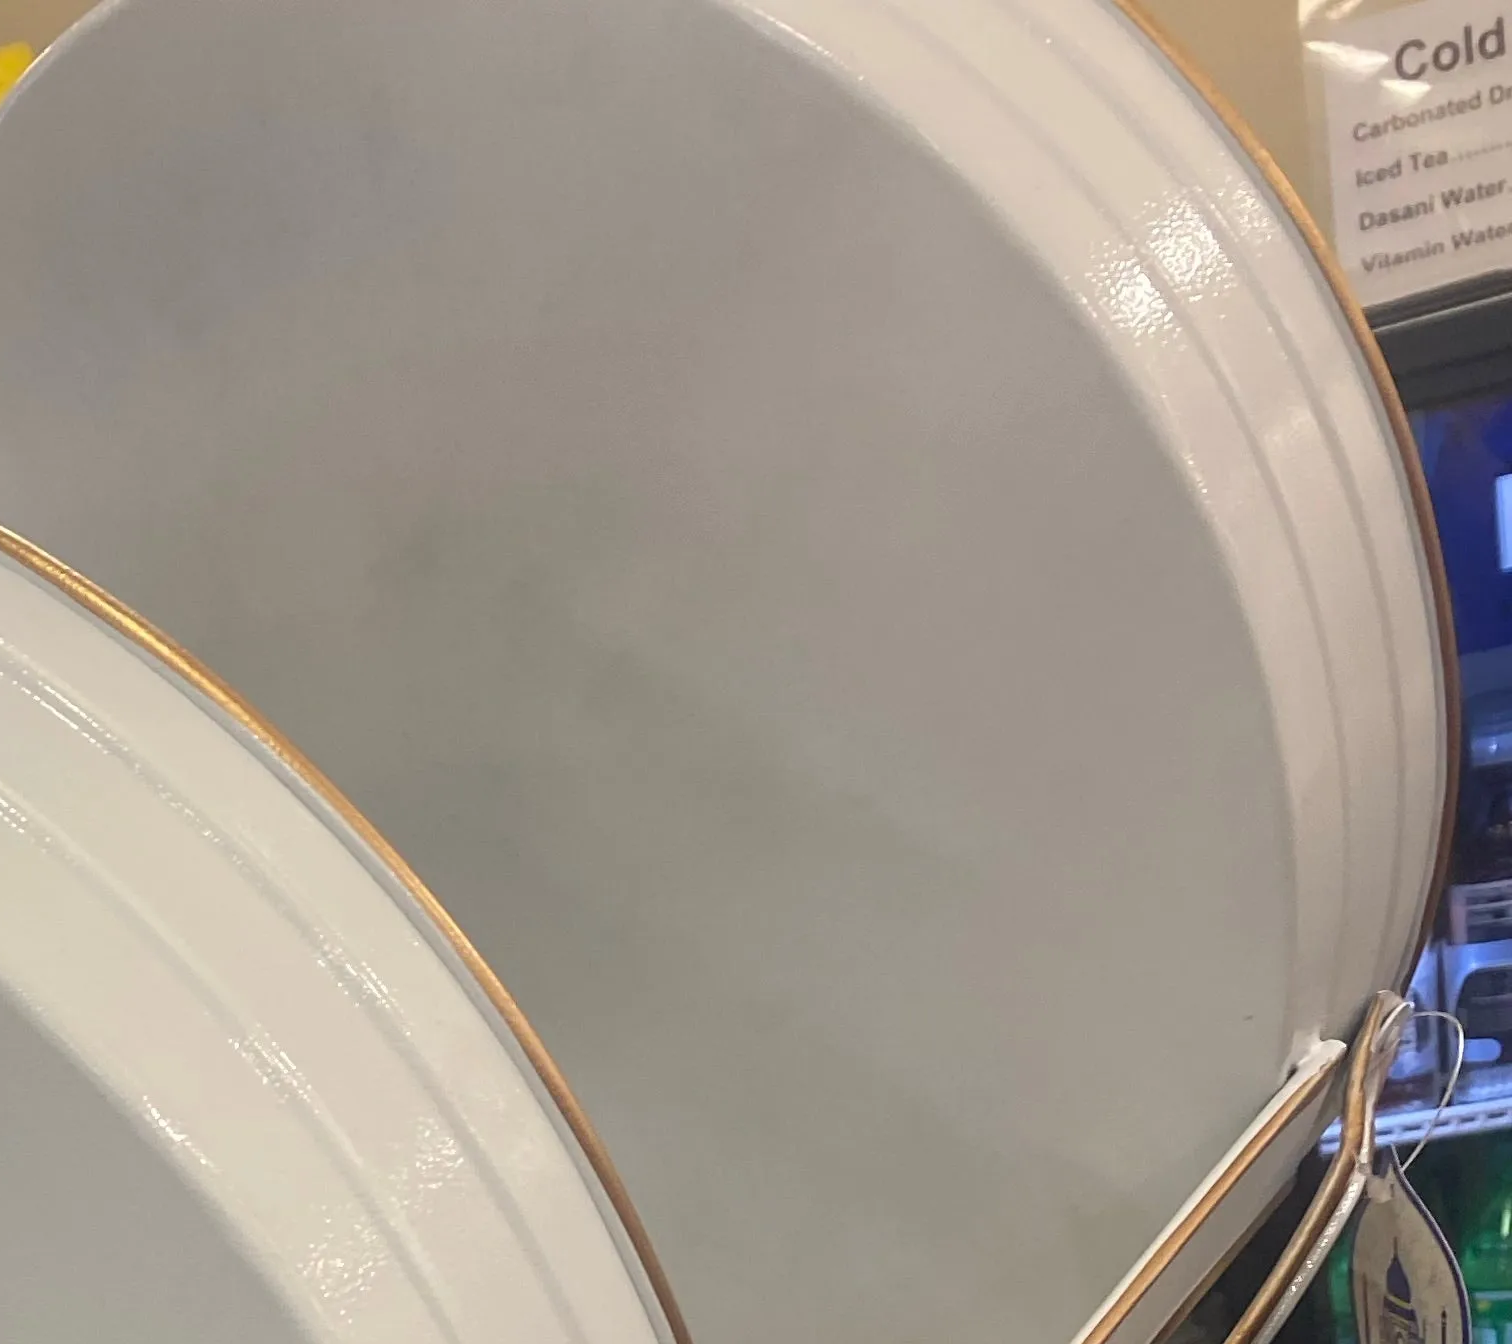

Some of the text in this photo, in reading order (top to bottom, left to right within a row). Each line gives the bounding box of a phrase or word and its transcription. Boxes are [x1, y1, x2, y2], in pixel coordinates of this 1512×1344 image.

[1395, 16, 1505, 80] Cold
[1353, 90, 1482, 142] Carbonated
[1356, 150, 1448, 187] Iced Tea
[1359, 178, 1507, 231] Dasani Water
[1361, 240, 1445, 272] Vitamin
